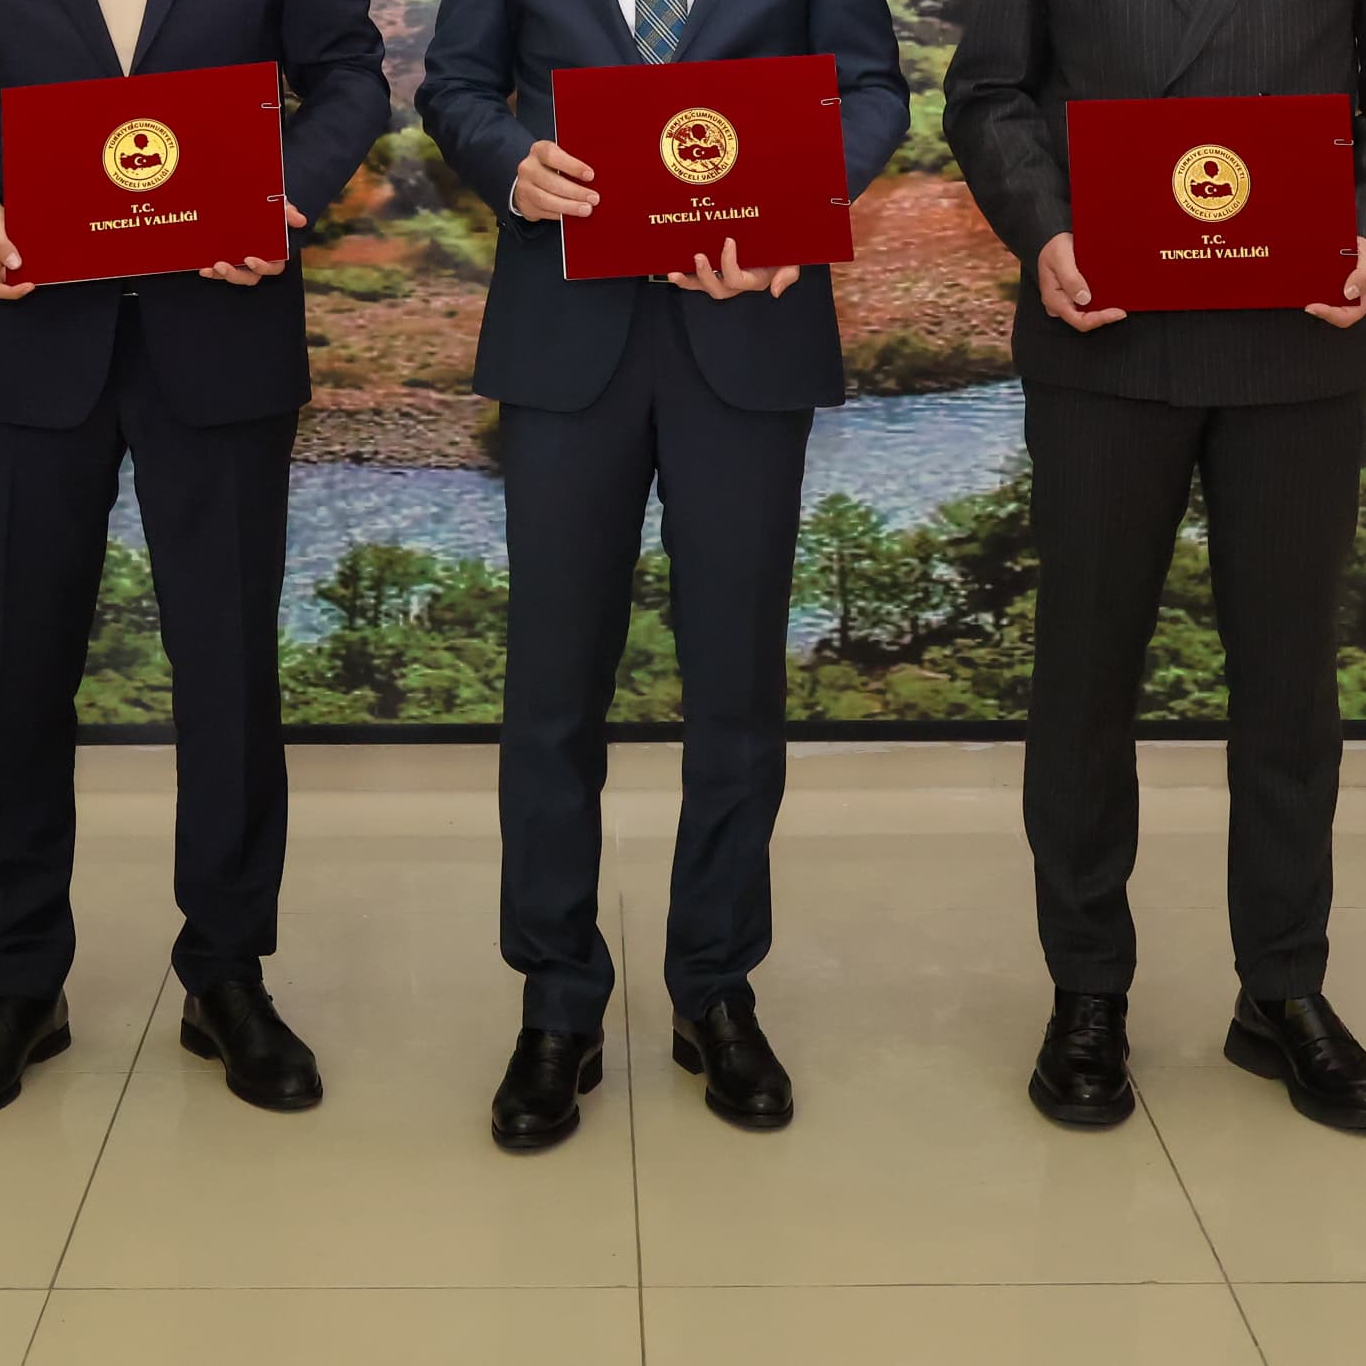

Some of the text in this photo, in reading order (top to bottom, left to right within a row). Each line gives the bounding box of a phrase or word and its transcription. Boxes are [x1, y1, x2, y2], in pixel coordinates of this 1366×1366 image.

[130, 202, 155, 214] T.C.
[690, 196, 715, 208] T.C.
[89, 209, 198, 231] TUNCELİ VALİLİĞİ
[648, 205, 760, 225] TUNCELİ VALİLİĞİ
[1201, 234, 1226, 245] T.C.
[1159, 245, 1270, 260] TUNCELİ VALİLİĞİ
